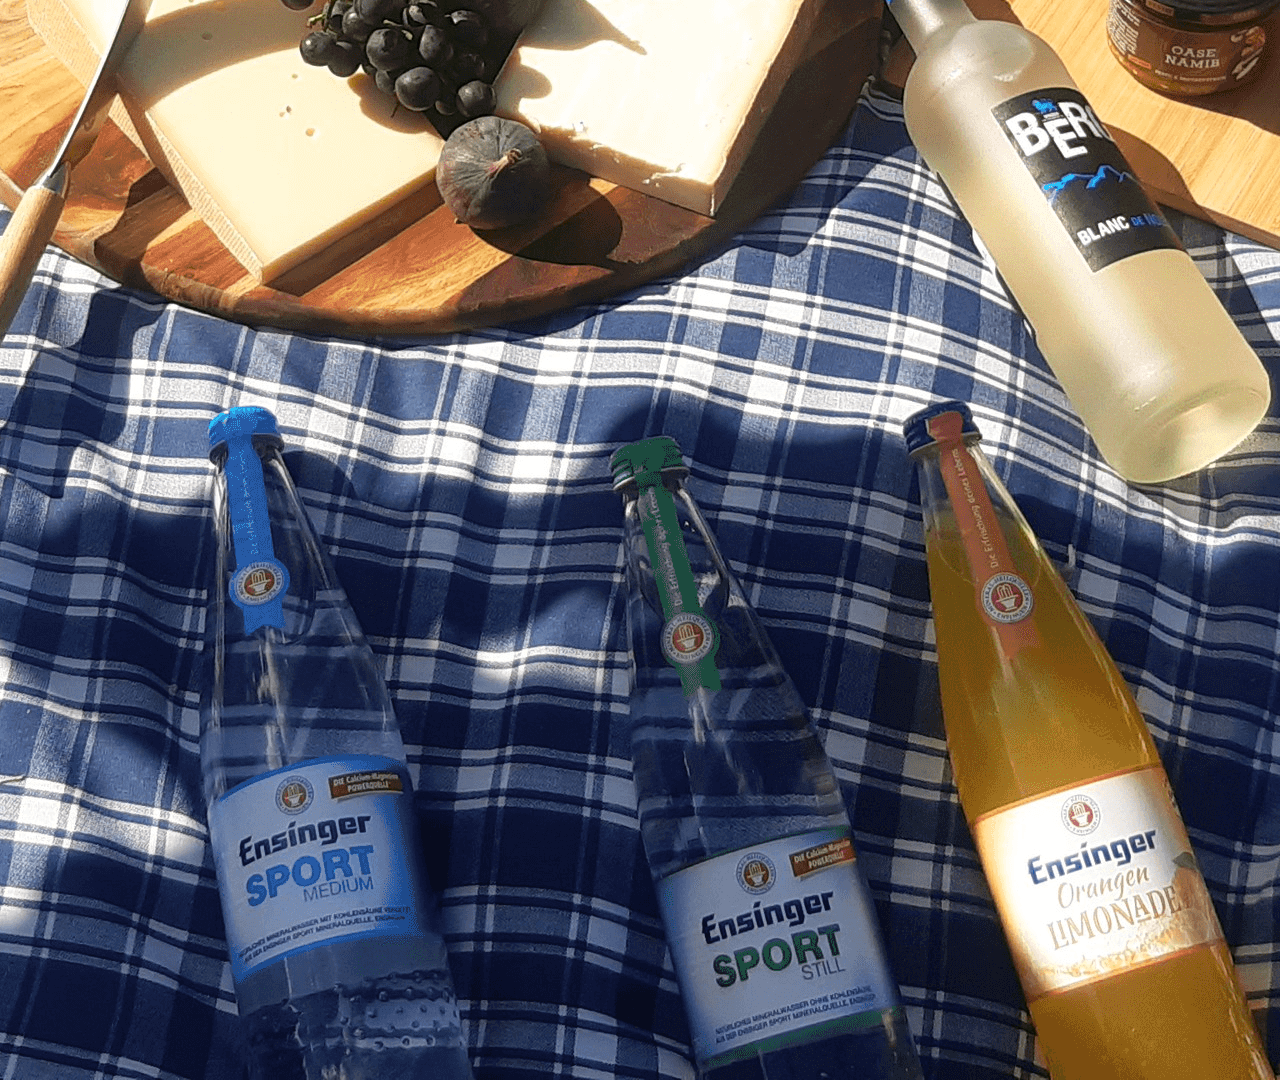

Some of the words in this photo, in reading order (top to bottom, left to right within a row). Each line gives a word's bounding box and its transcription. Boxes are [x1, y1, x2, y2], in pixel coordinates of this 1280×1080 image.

[1165, 54, 1221, 69] NAMIB
[1171, 45, 1217, 58] OASE
[1076, 216, 1130, 246] BLANC
[972, 504, 993, 552] Erfrischung
[239, 815, 372, 866] Ensinger
[1027, 829, 1157, 885] Ensinger
[246, 844, 374, 907] SPORT
[303, 877, 374, 903] MEDIUM
[1057, 866, 1150, 909] Orangen
[702, 891, 833, 944] Ensinger
[1047, 885, 1181, 951] LIMONADE
[713, 923, 840, 987] SPORT
[802, 957, 846, 980] STILL
